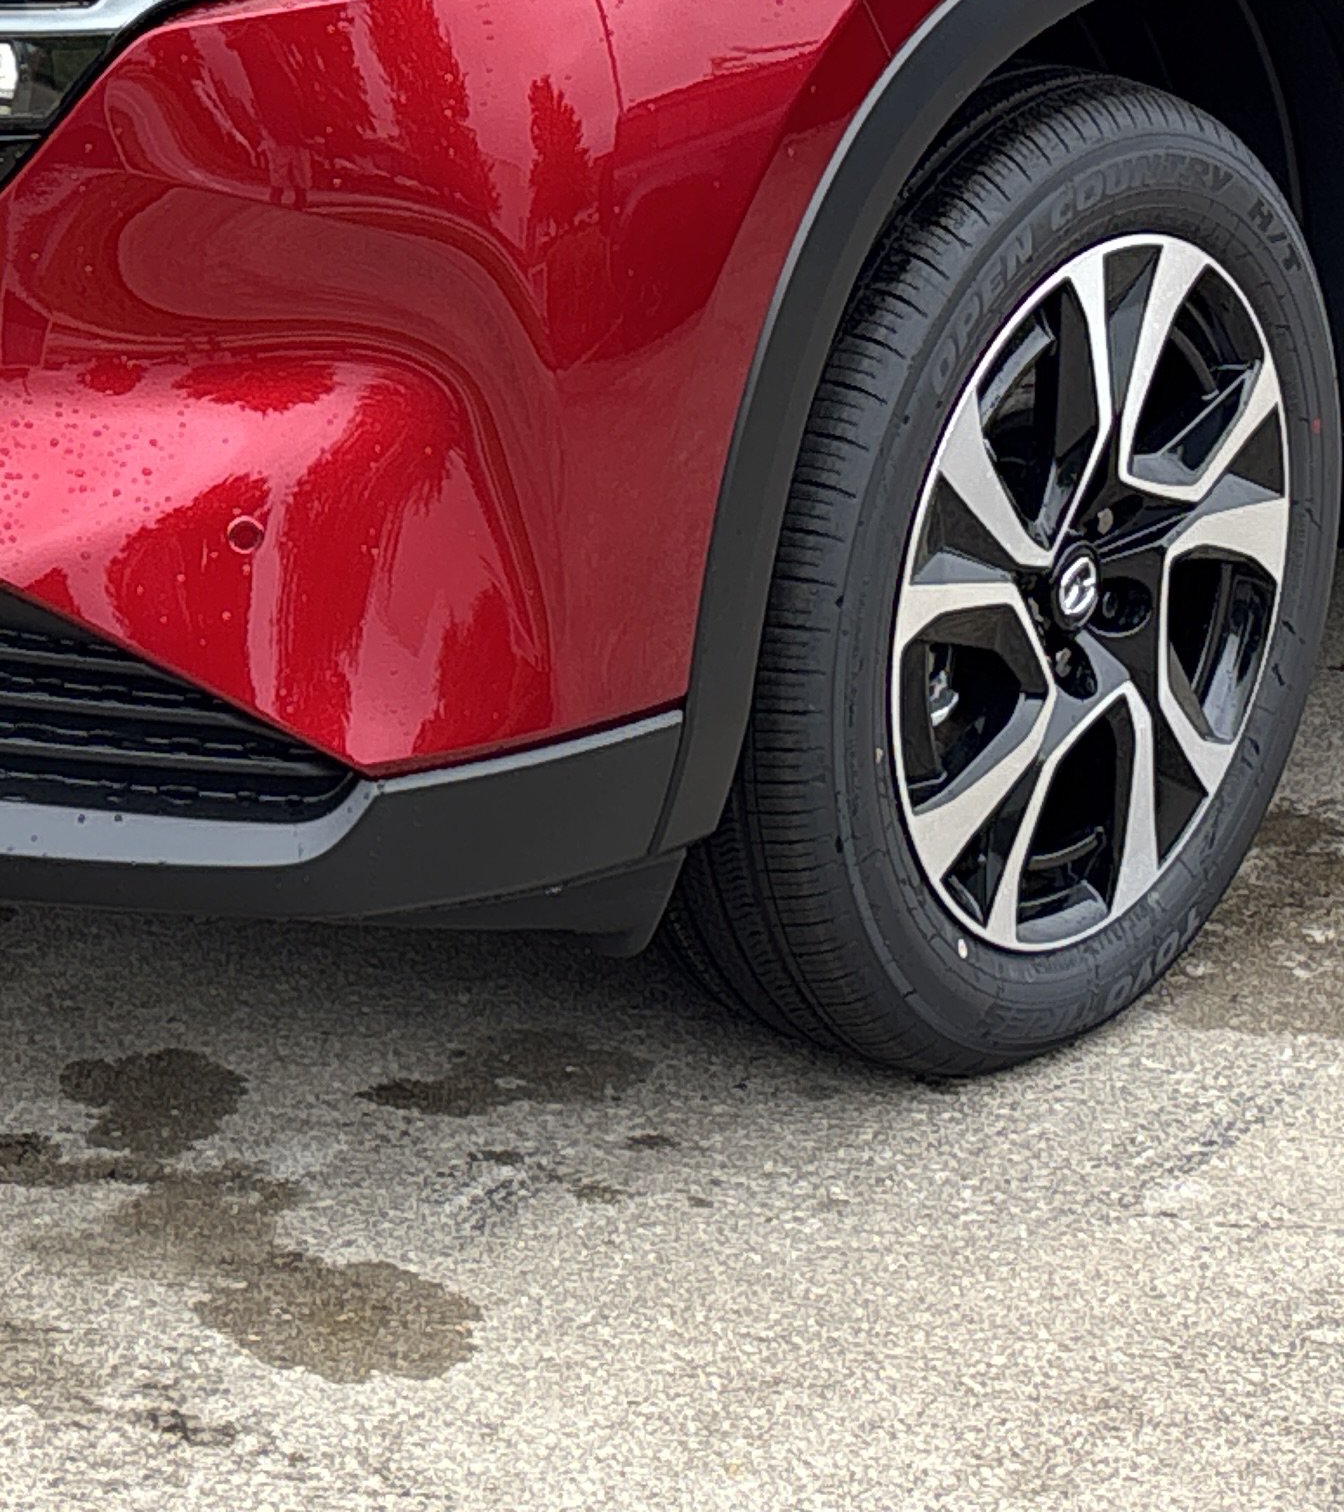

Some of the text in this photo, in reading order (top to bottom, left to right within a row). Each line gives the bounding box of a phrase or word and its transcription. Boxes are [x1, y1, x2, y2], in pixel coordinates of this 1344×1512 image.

[932, 154, 1304, 394] OPEN COUNTRY H/T
[1103, 905, 1201, 1015] TOYO
[982, 1000, 1098, 1042] TIRES
